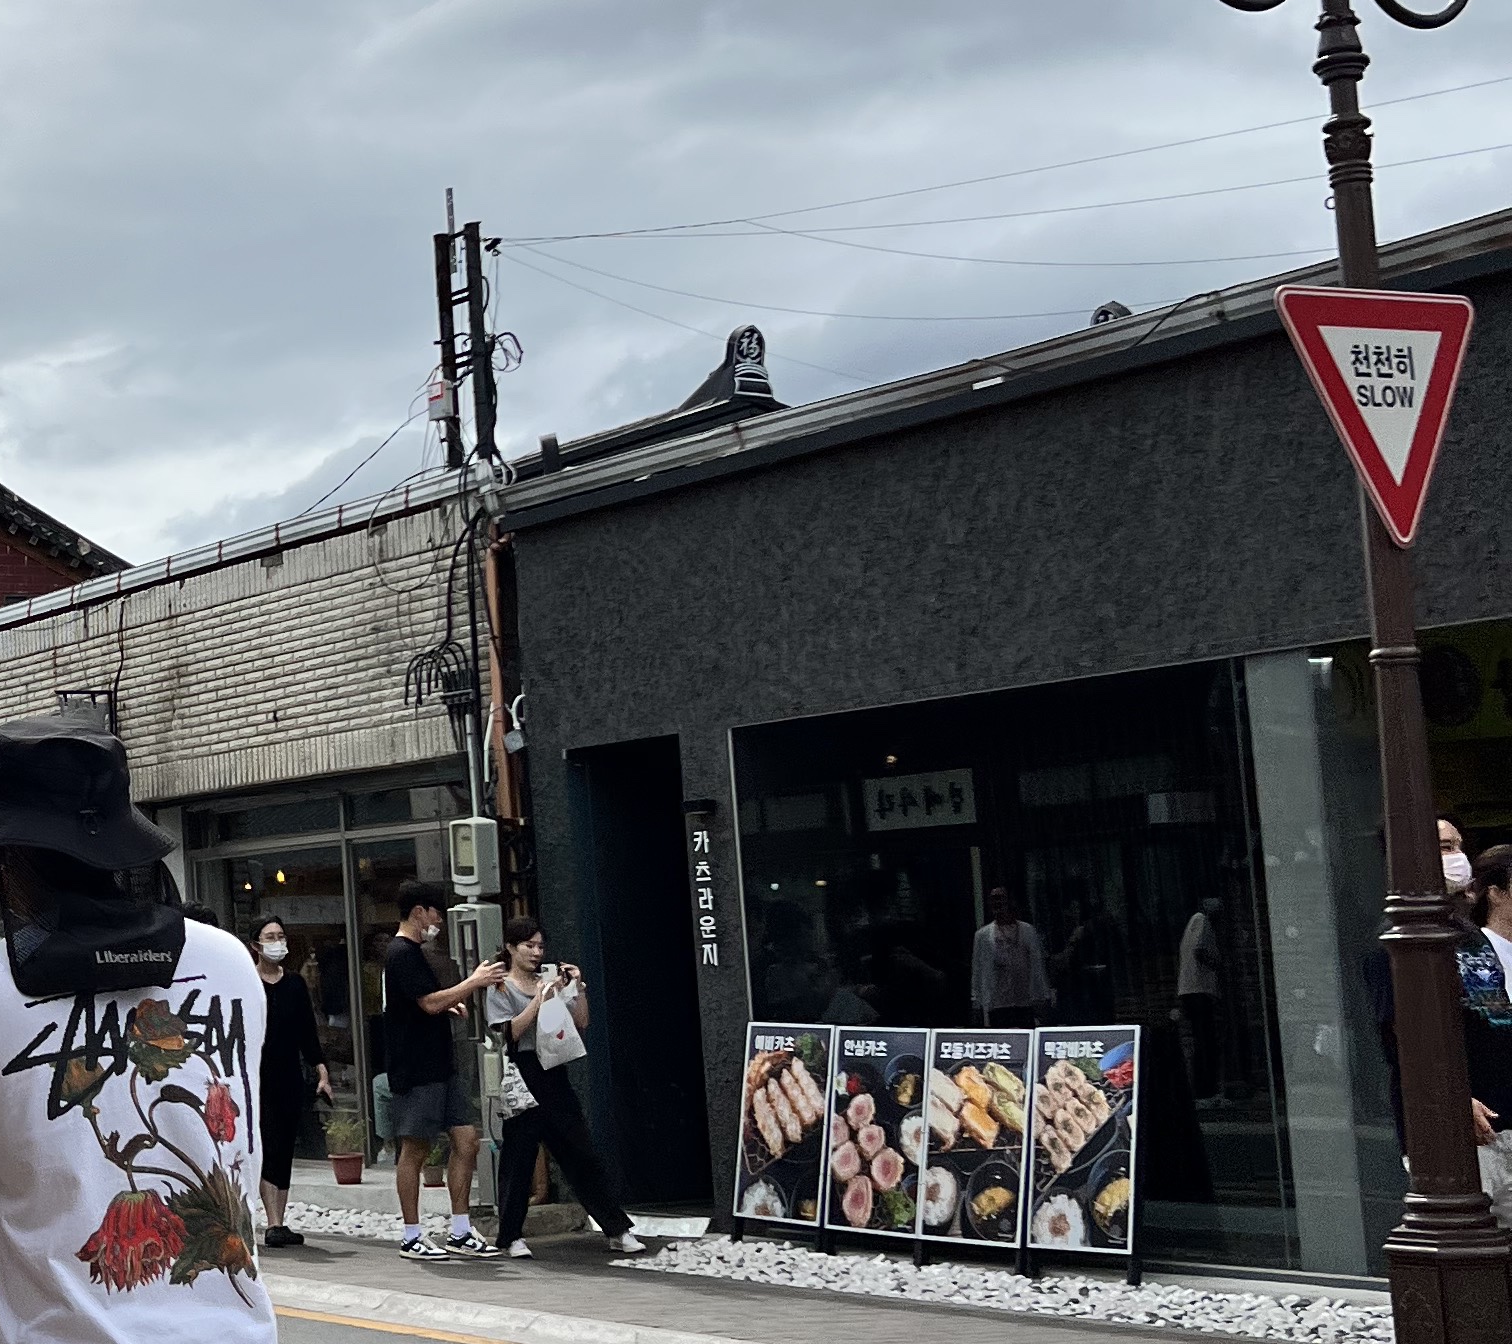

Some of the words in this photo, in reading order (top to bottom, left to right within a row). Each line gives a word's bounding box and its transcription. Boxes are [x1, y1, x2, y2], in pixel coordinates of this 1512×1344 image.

[1351, 344, 1416, 381] 천천히
[1357, 384, 1415, 408] SLOW
[693, 830, 719, 966] 카츠라운지
[843, 1039, 888, 1057] 안심카츠
